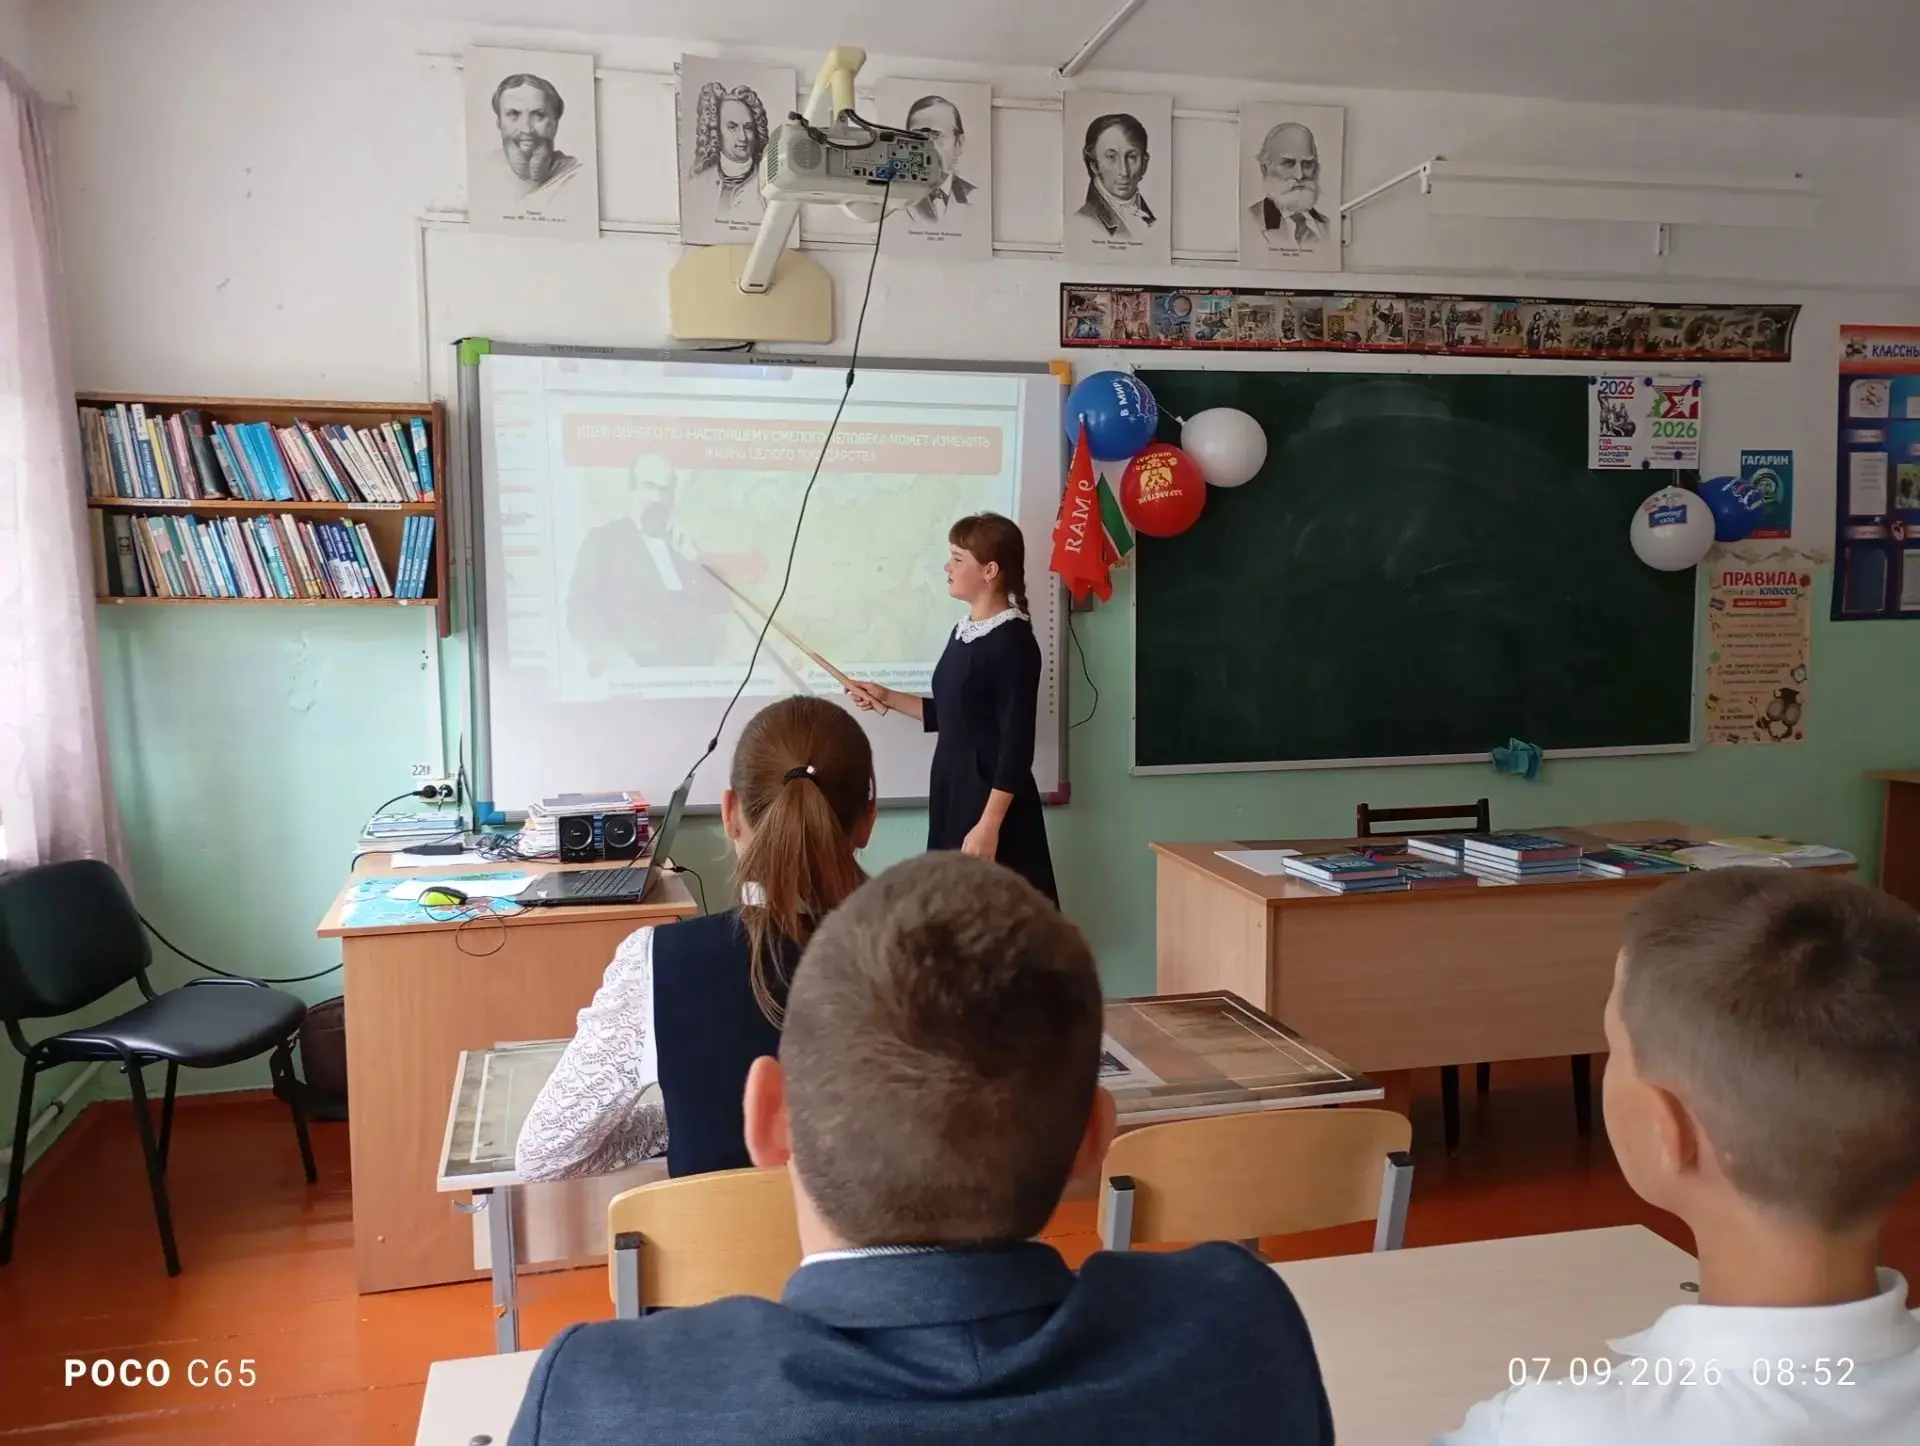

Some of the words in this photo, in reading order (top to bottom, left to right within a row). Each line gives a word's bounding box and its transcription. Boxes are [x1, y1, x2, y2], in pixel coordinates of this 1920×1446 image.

[1600, 381, 1634, 395] 2026
[1652, 421, 1697, 438] 2026
[1742, 455, 1789, 466] ГАГАРИН
[1723, 571, 1798, 586] ПРАВИЛА
